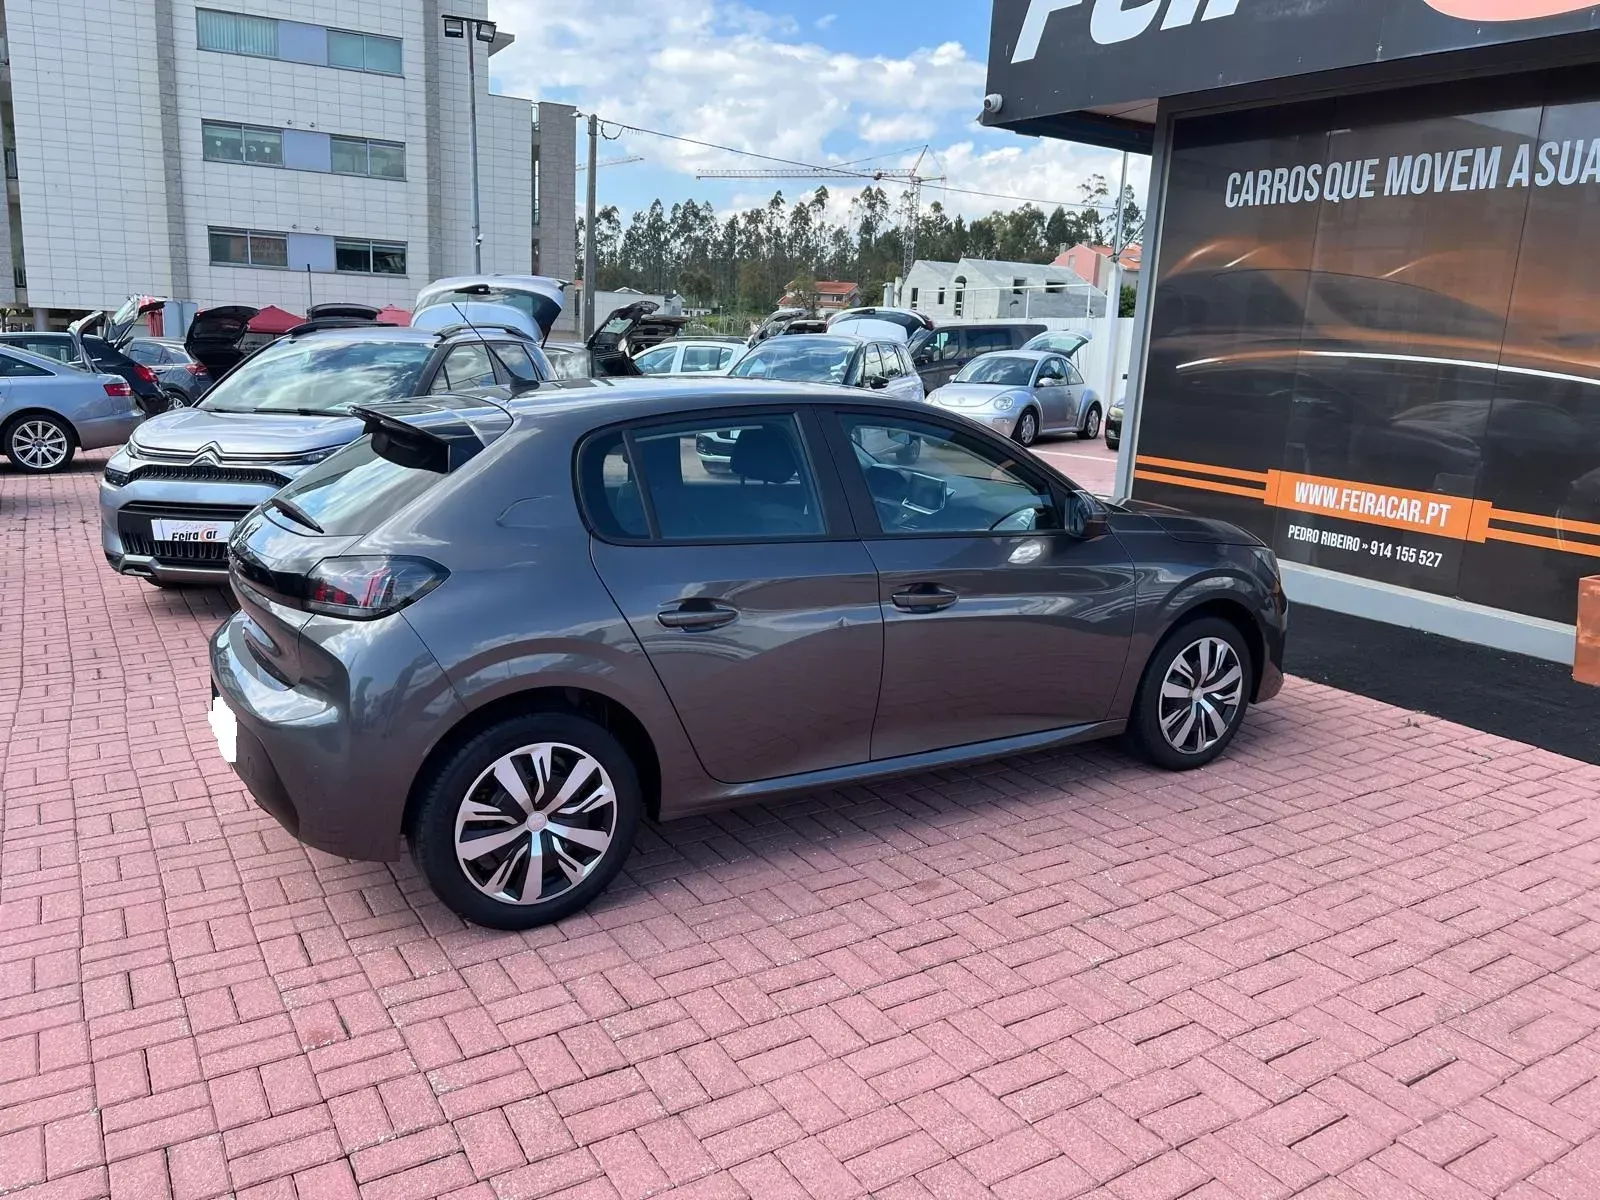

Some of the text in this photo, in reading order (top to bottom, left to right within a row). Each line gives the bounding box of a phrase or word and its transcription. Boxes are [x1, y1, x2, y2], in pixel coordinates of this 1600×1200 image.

[1225, 137, 1600, 208] CARROS QUE MOVEM A SUA
[1295, 481, 1452, 527] WWW.FEIRACAR.PT
[1288, 524, 1319, 544] PEDRO
[1320, 530, 1360, 552] RIBEIRO
[1370, 540, 1392, 558] 914
[1395, 545, 1417, 563] 155
[1418, 550, 1443, 568] 527
